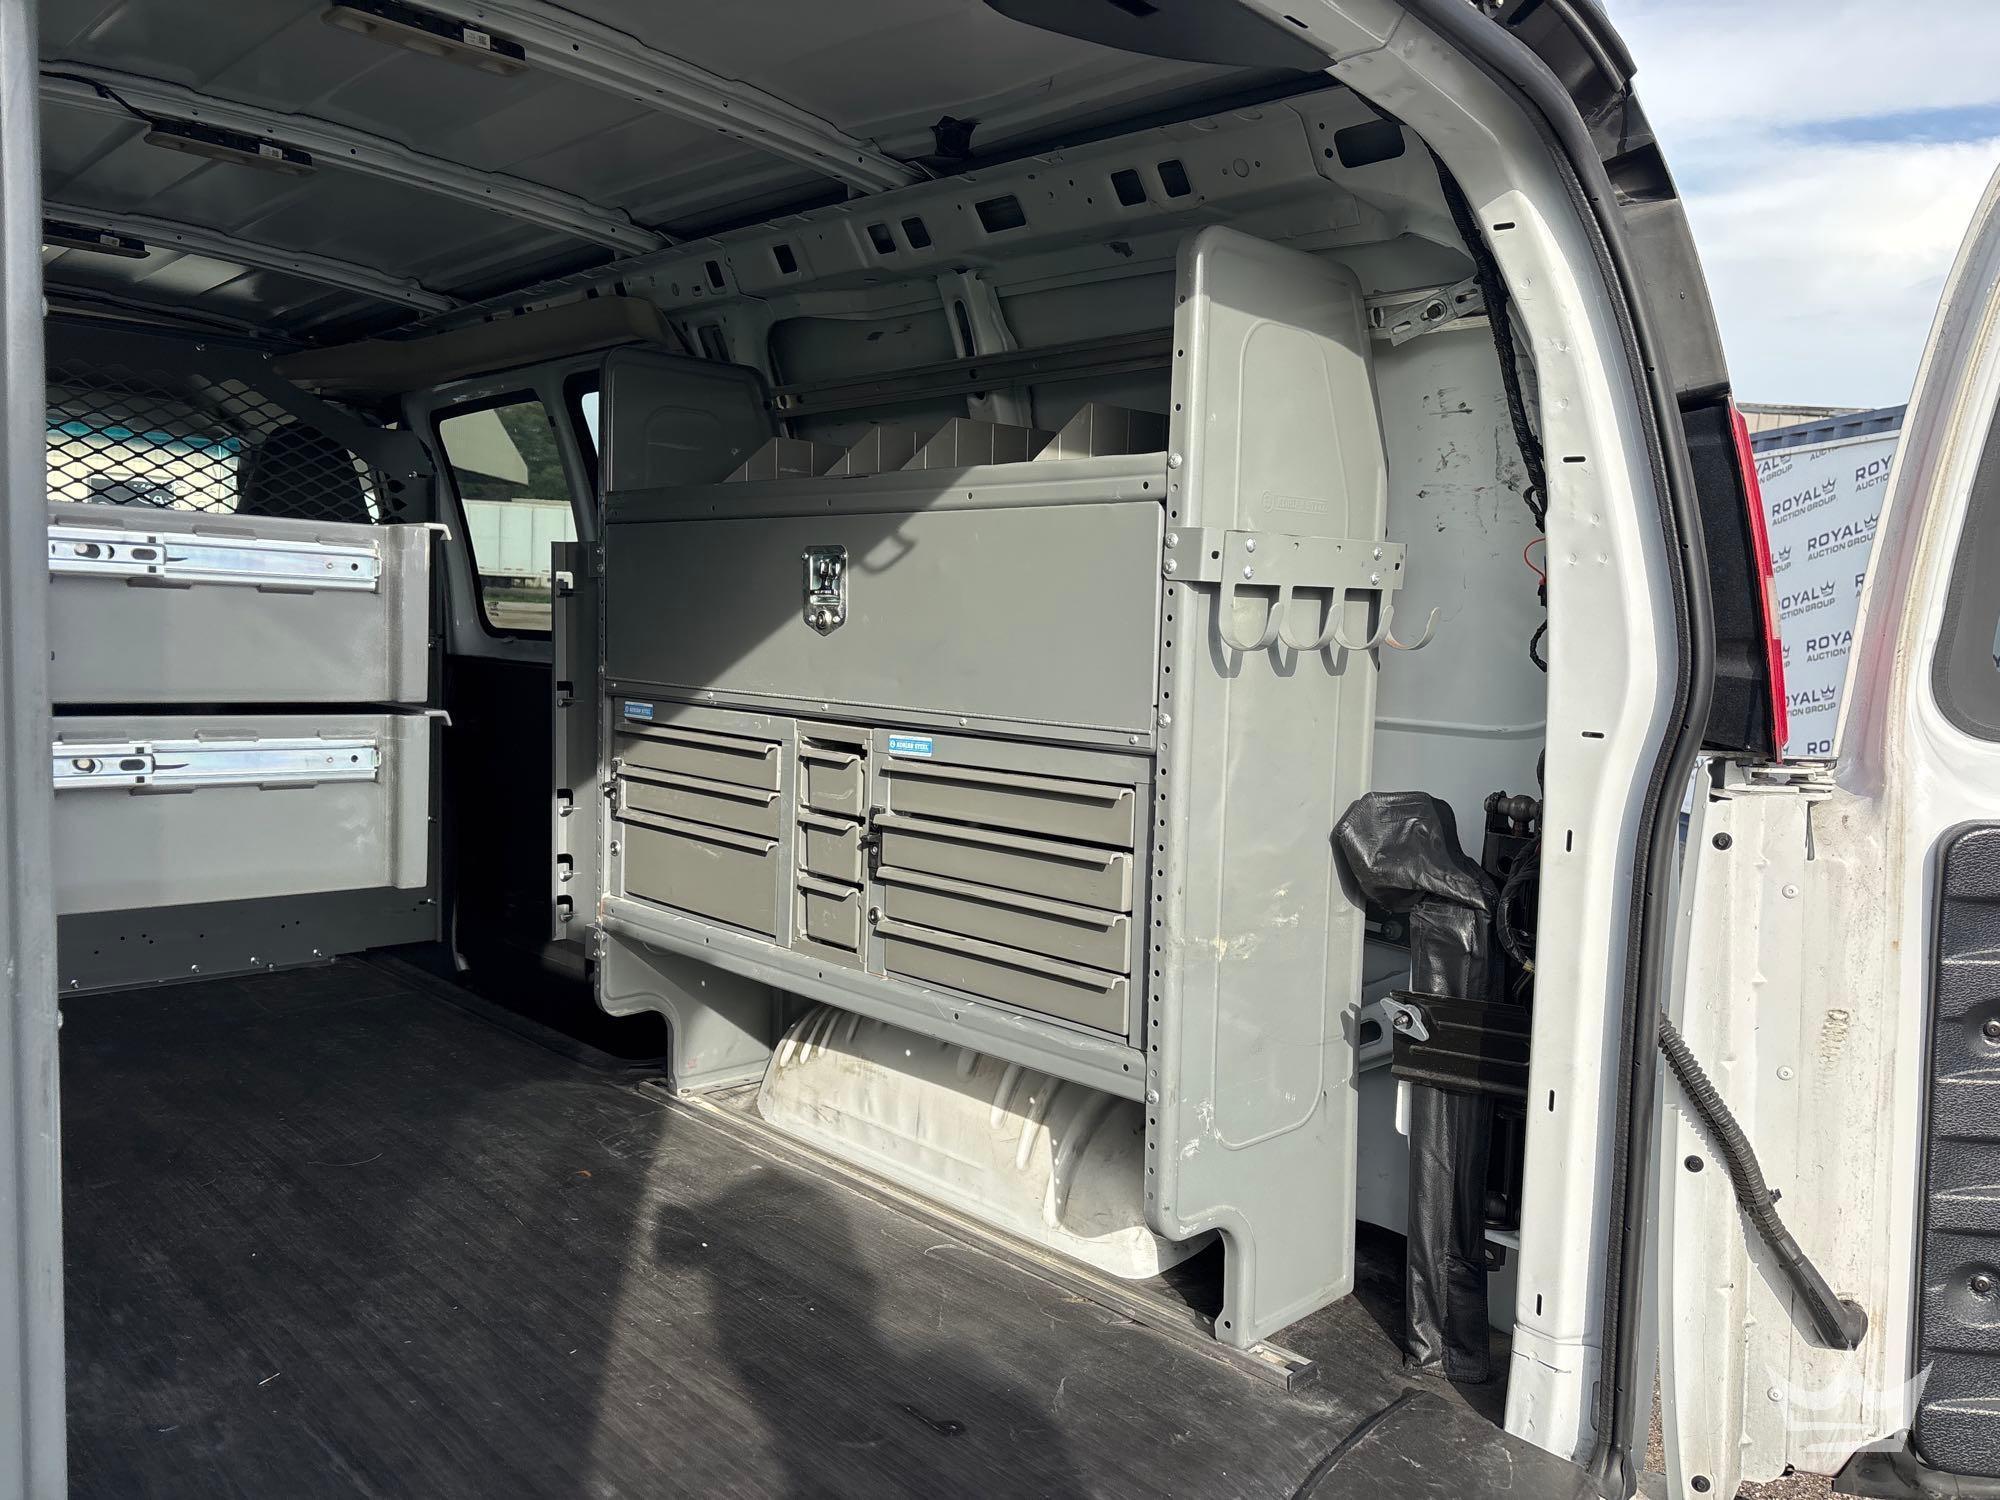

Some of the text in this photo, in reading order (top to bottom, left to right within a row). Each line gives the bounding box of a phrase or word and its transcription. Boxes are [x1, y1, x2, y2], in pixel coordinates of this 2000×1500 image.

[1757, 456, 1779, 474] YAL
[1766, 464, 1792, 481] GROUP
[1856, 455, 1892, 481] ROY
[1856, 473, 1889, 492] AUCTIO
[1772, 487, 1821, 517] ROYAL
[1772, 494, 1836, 525] AUCTION GROUP
[1807, 522, 1863, 551] ROYAL
[1808, 543, 1846, 561] AUCTION
[1778, 587, 1819, 610] OYAL
[1780, 597, 1835, 620] CTION GROUP
[1807, 630, 1852, 653] ROYA
[1807, 647, 1846, 662] AUCTION
[1786, 690, 1821, 707] YAL
[1805, 702, 1836, 714] GROUP
